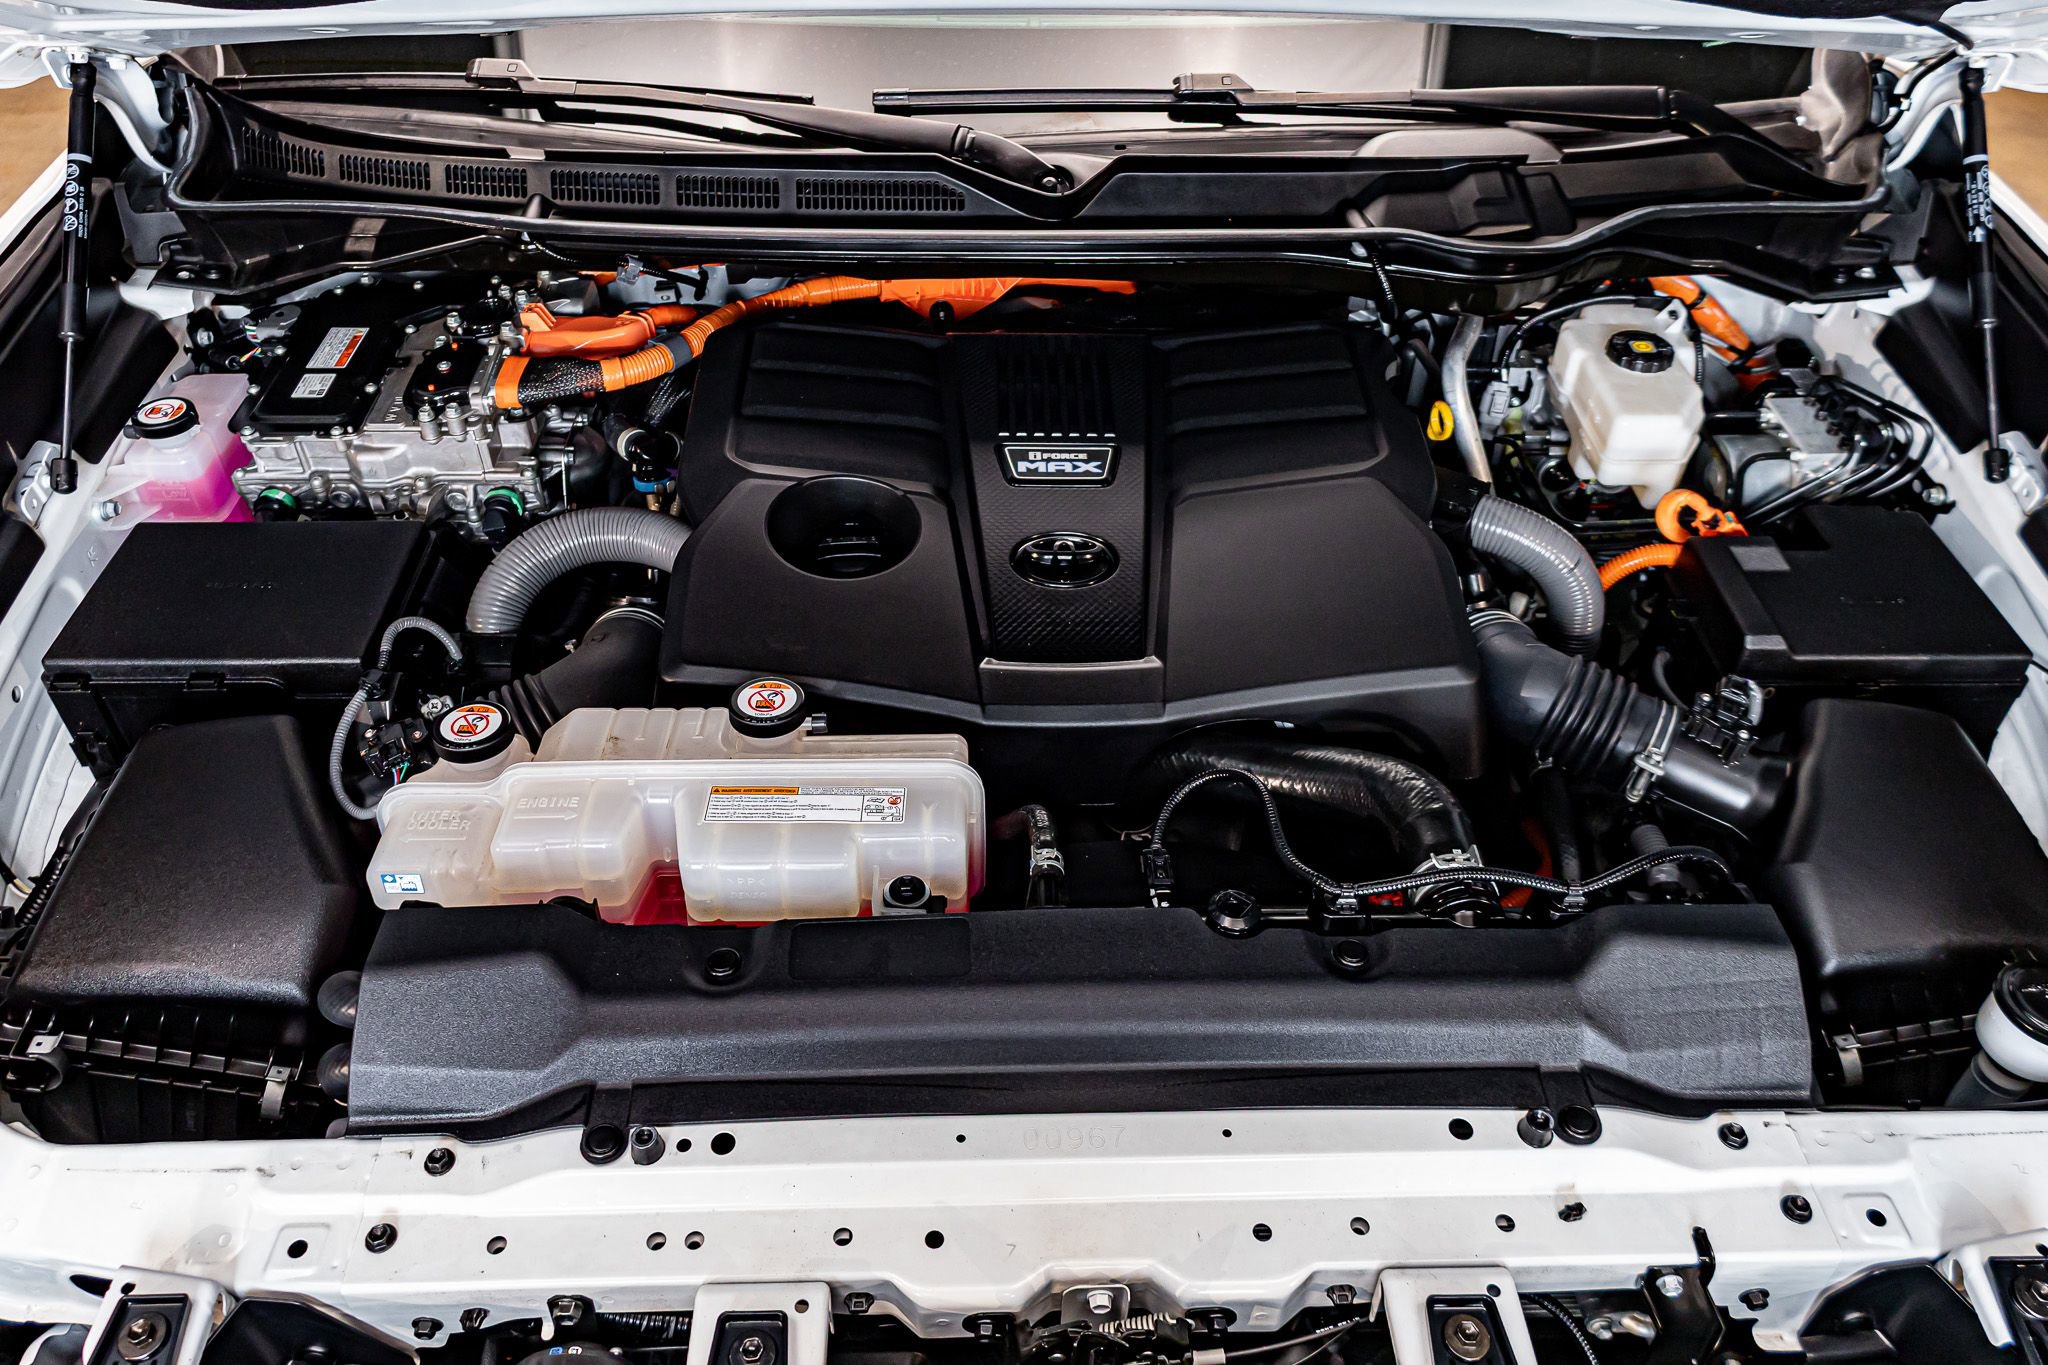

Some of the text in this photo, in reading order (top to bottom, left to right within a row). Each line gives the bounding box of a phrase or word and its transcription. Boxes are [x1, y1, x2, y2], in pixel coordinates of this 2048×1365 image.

[1017, 461, 1103, 473] MAX
[517, 796, 581, 809] ENGINE
[409, 810, 463, 821] INTER
[406, 820, 472, 831] COOLER
[1023, 1125, 1126, 1150] 00967
